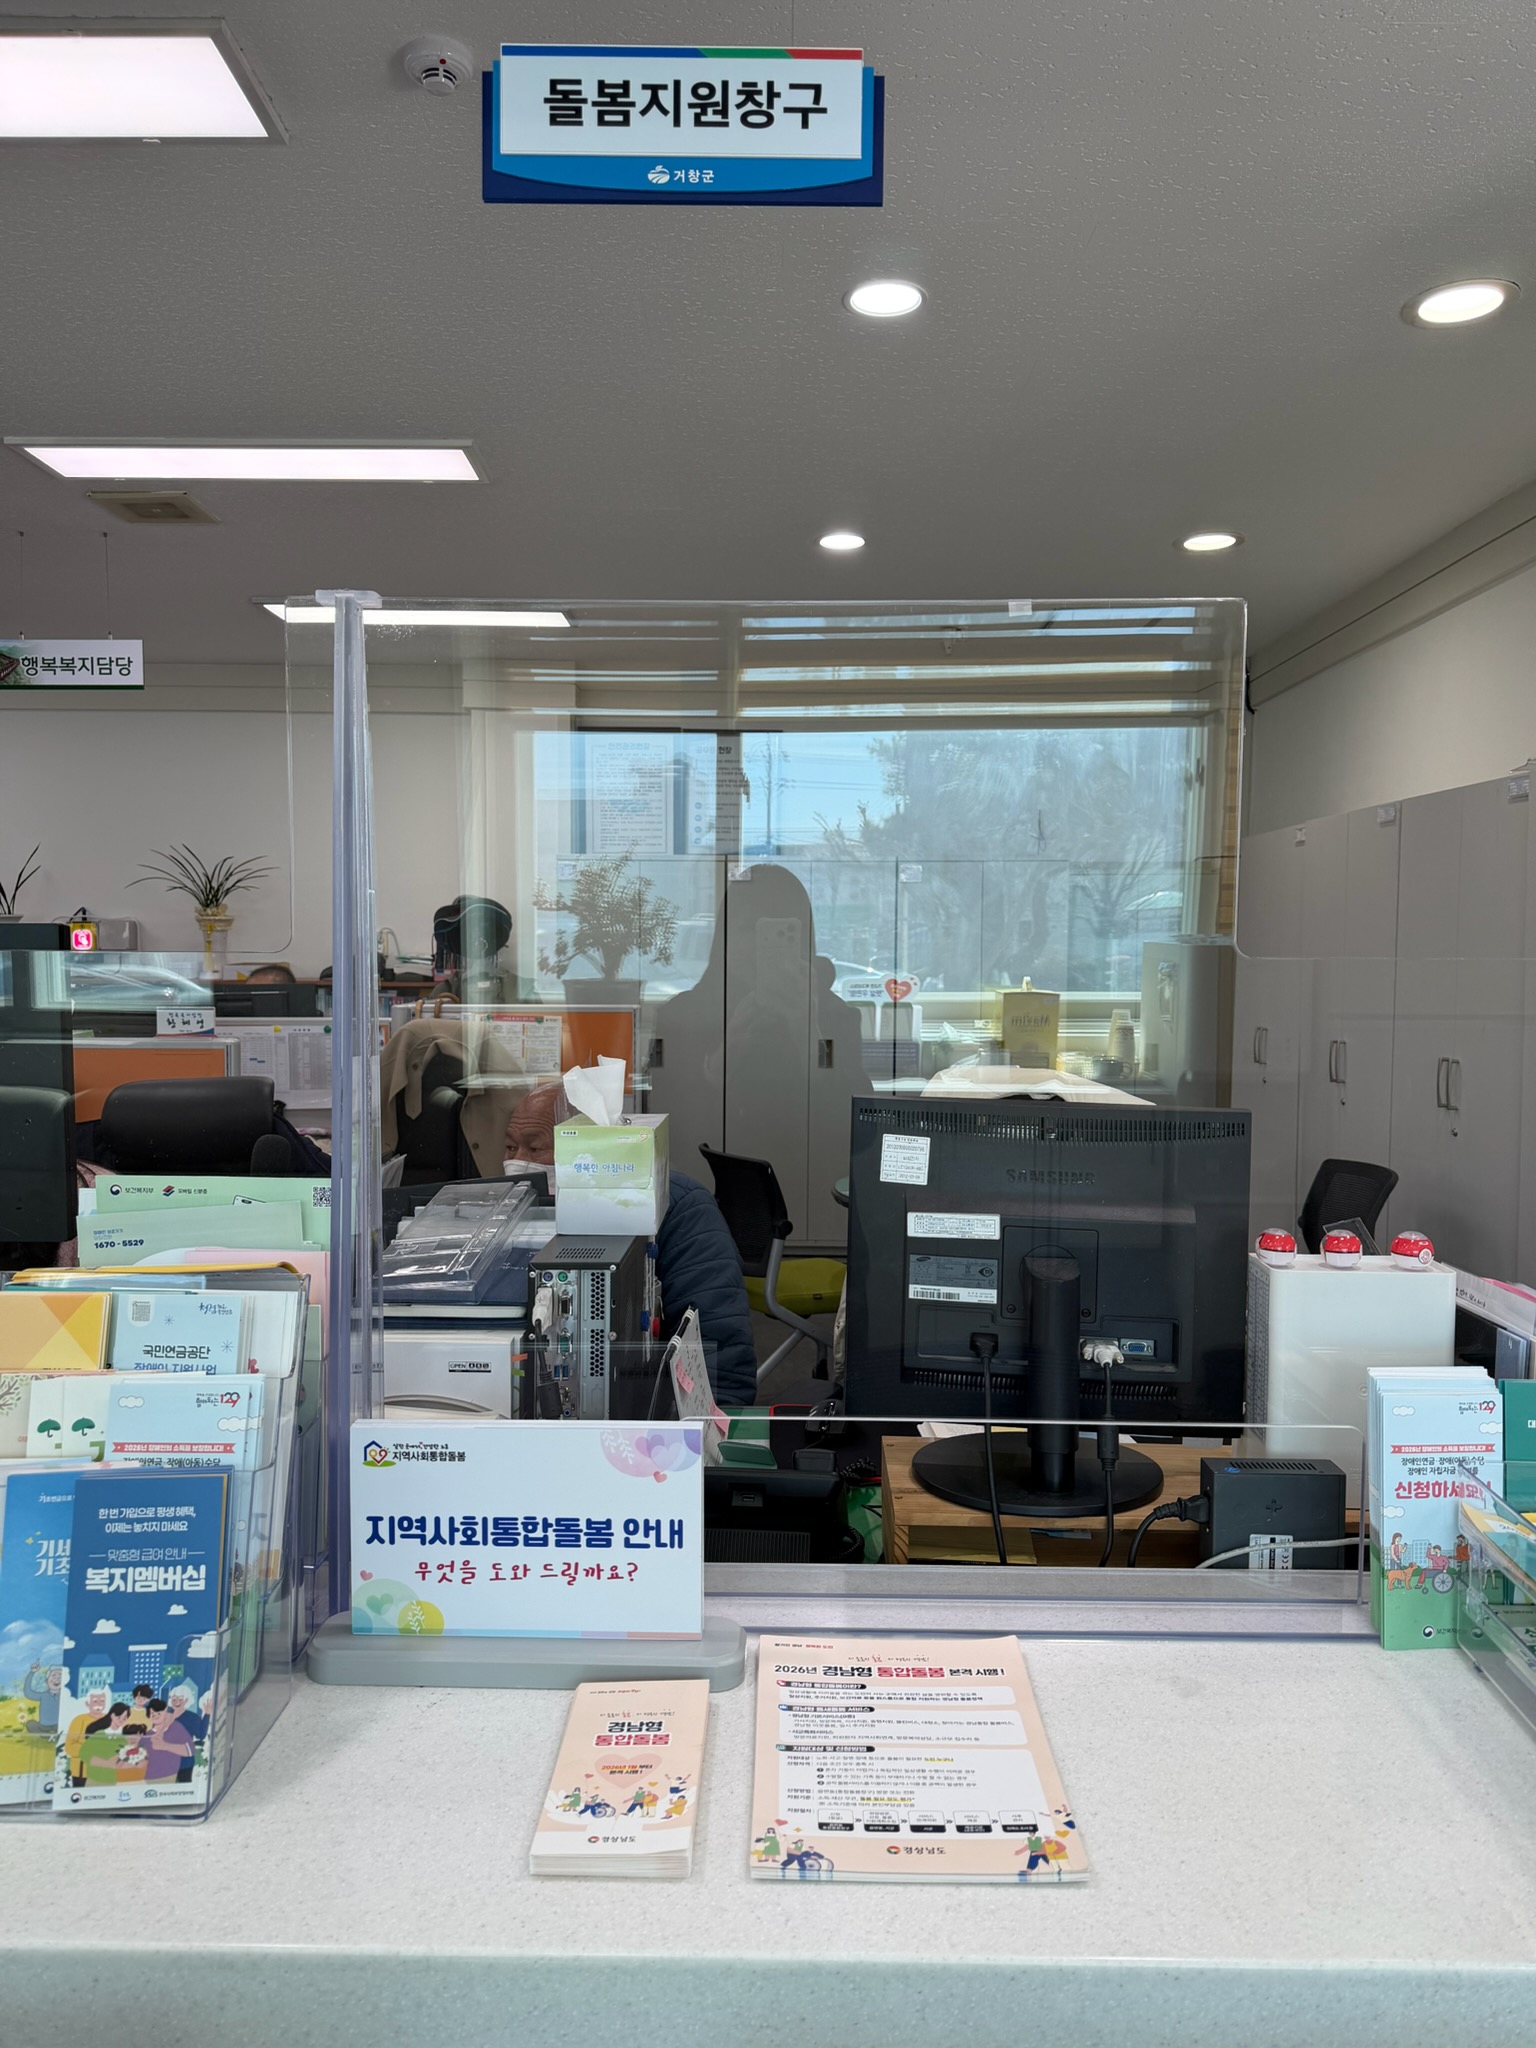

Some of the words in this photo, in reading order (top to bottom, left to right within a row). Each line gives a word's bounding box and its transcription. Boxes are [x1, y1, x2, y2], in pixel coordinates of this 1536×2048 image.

[543, 78, 828, 130] 돌봄지원창구
[673, 168, 715, 184] 거창군
[20, 656, 133, 677] 행복복지담당
[142, 1344, 211, 1359] 국민연금공단
[220, 1391, 241, 1408] 129
[1479, 1400, 1497, 1414] 129
[392, 1451, 466, 1462] 지역사회통합돌봄
[98, 1508, 109, 1519] 한
[110, 1508, 120, 1518] 번
[120, 1507, 156, 1518] 가입으로
[156, 1506, 175, 1518] 평생
[176, 1506, 196, 1518] 혜택,
[105, 1523, 132, 1534] 이제는
[134, 1522, 160, 1532] 놓치지
[162, 1521, 188, 1532] 마세요
[365, 1515, 614, 1548] 지역사회통합돌봄
[622, 1518, 684, 1550] 안내
[107, 1549, 140, 1562] 맞춤형
[142, 1548, 164, 1561] 급여
[165, 1548, 187, 1560] 안내
[85, 1564, 206, 1594] 복지멤버십
[414, 1559, 478, 1586] 무엇을
[489, 1562, 531, 1584] 도와
[540, 1562, 639, 1586] 드릴까요?
[774, 1664, 818, 1674] 2026년
[822, 1665, 873, 1678] 경남형
[876, 1666, 945, 1678] 통합돌봄
[949, 1668, 972, 1677] 본격
[608, 1720, 663, 1733] 경남형
[594, 1733, 670, 1746] 통합돌봄
[602, 1836, 636, 1844] 경상남도
[903, 1846, 946, 1856] 경상남도
